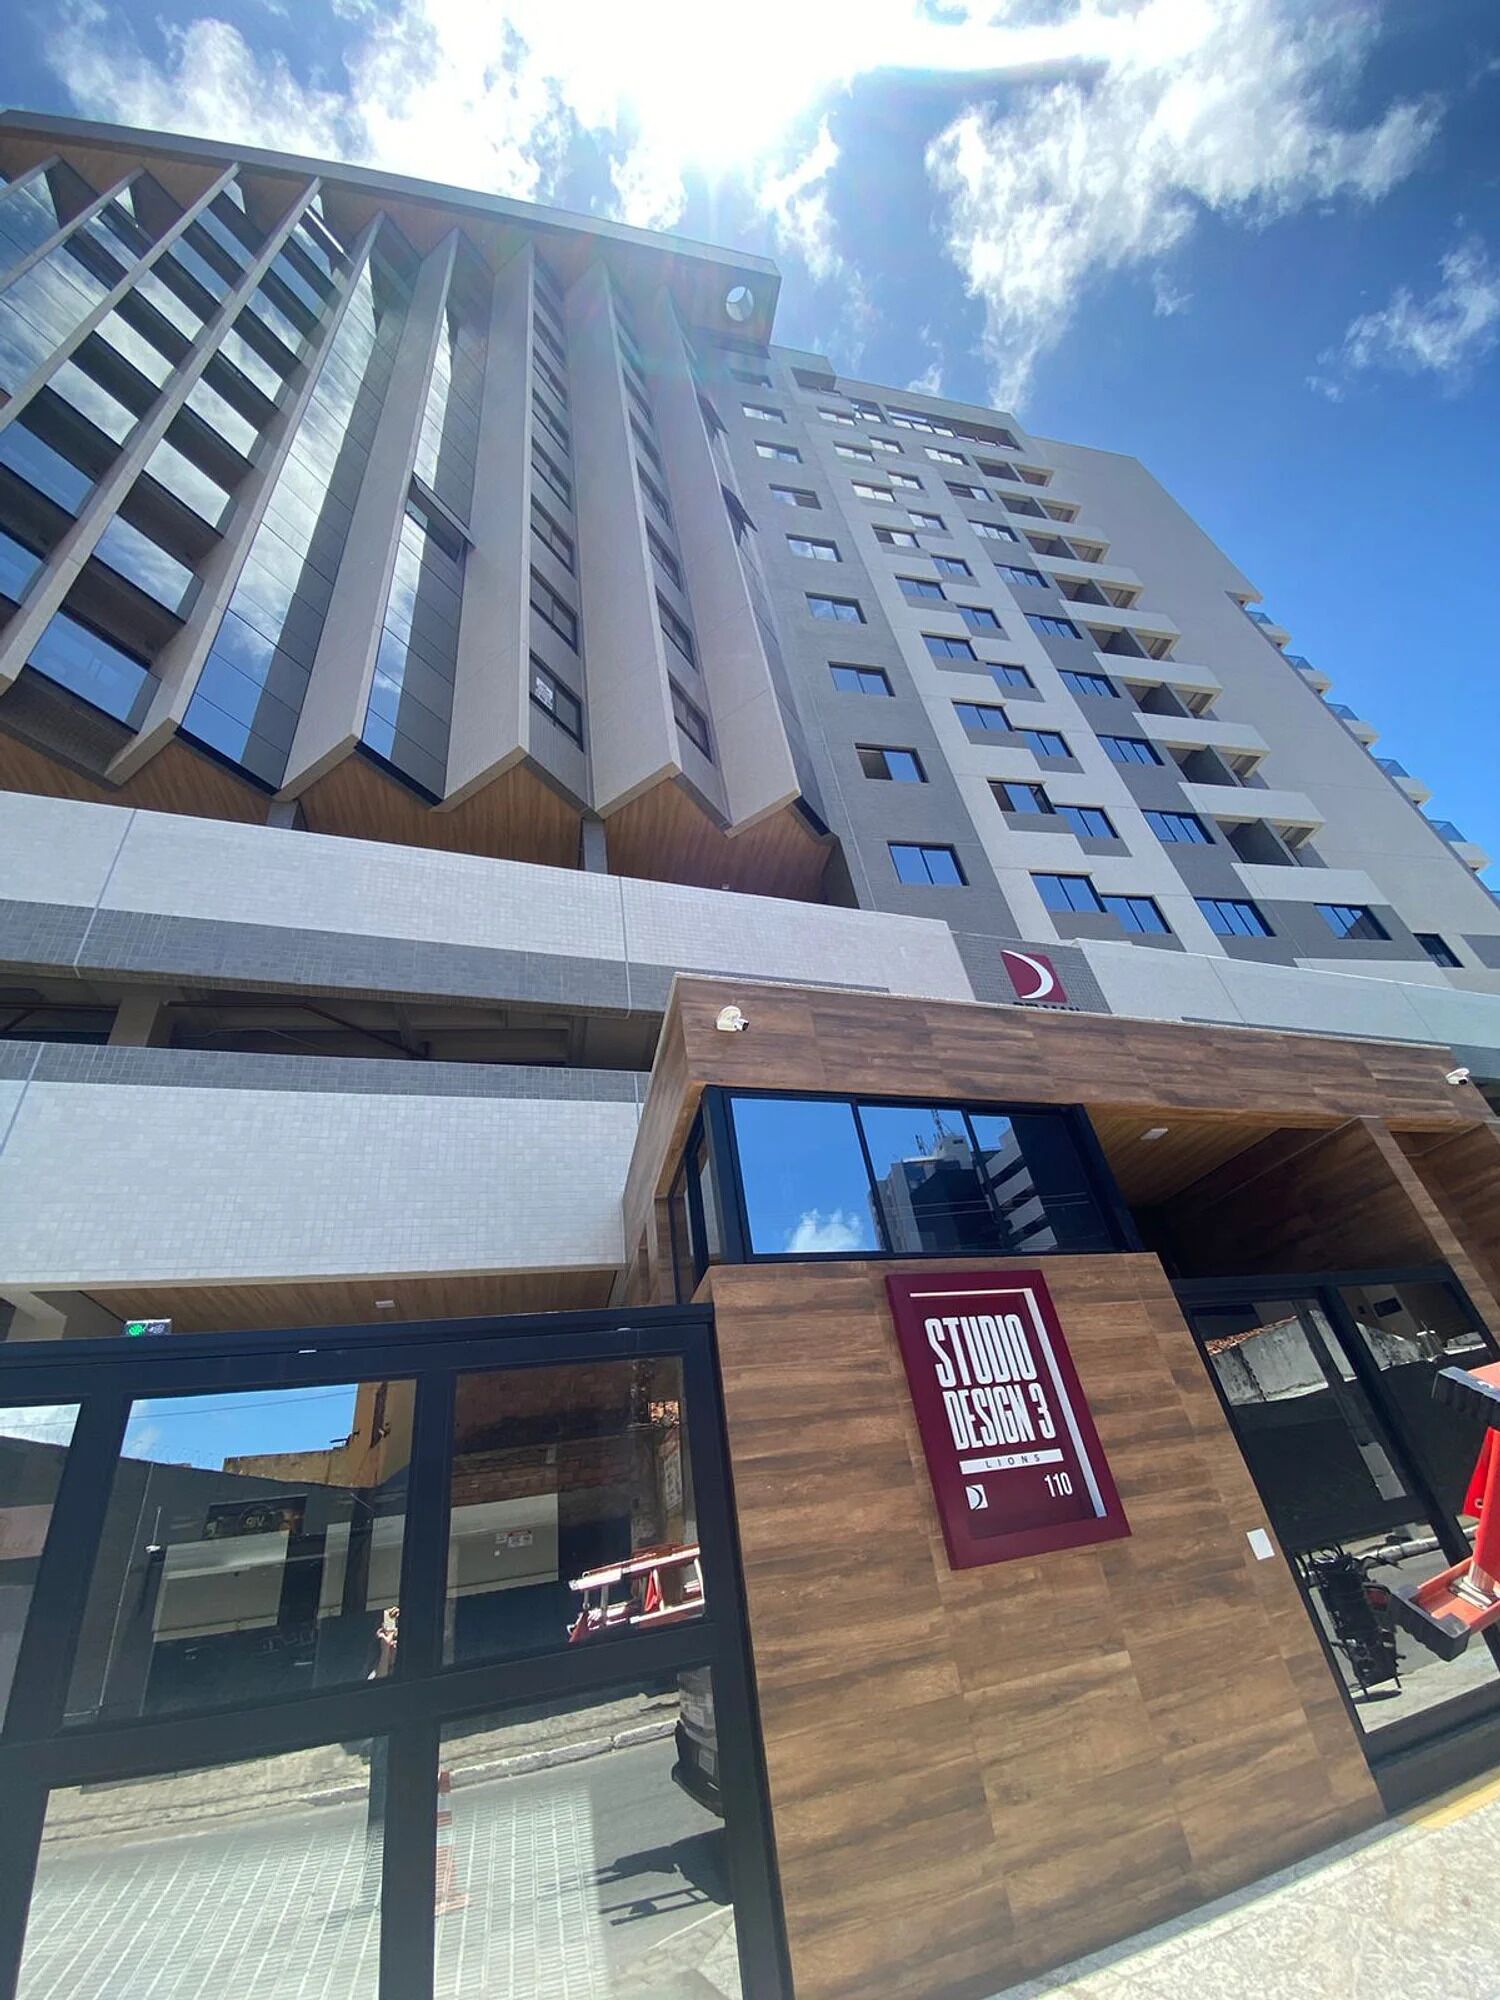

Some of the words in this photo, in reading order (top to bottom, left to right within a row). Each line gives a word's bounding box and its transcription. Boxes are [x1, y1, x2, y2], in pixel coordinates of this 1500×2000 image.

[924, 1314, 1038, 1388] STUDIO
[942, 1385, 1036, 1450] DESIGN
[1032, 1383, 1056, 1440] 3
[985, 1454, 1041, 1469] LIONS
[1044, 1471, 1073, 1498] 110
